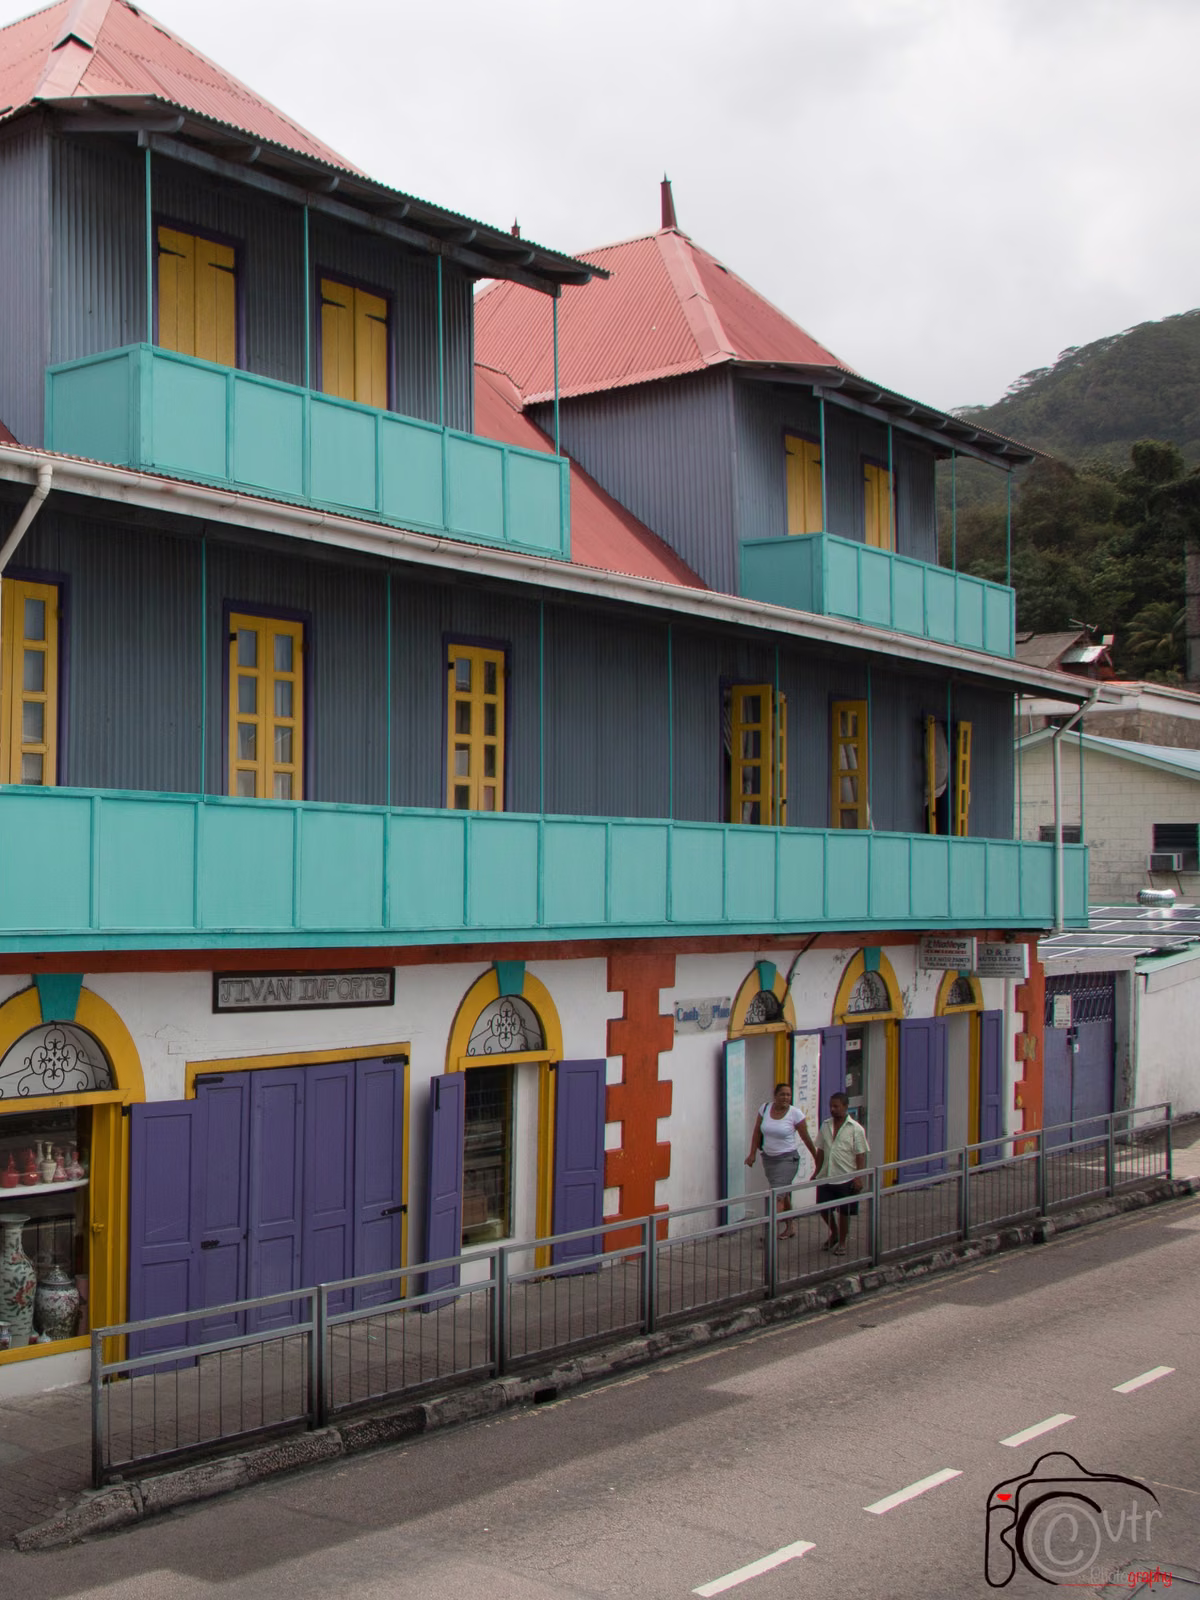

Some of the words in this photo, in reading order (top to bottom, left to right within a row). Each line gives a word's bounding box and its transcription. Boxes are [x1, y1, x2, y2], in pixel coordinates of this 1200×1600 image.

[220, 979, 293, 1004] JIVAN
[298, 976, 387, 1002] IMPORTS
[676, 1006, 699, 1022] Cash
[712, 1004, 730, 1018] Plus
[798, 1063, 808, 1101] Plus
